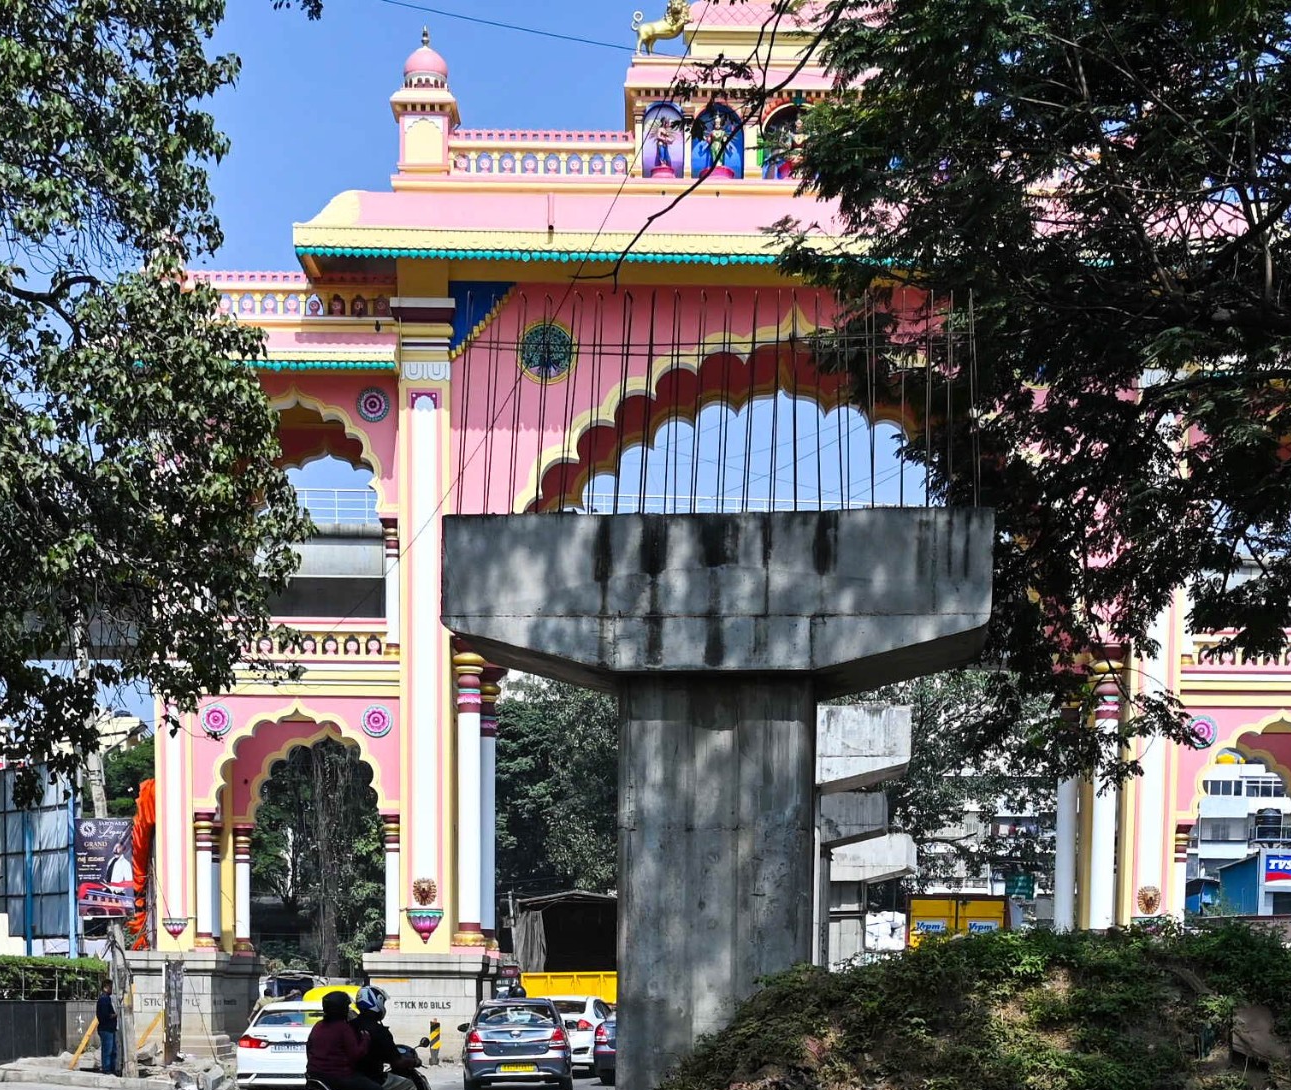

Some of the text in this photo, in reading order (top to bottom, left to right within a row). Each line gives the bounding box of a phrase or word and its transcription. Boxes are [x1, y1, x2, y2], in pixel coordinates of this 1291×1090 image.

[394, 1001, 451, 1009] STICK NO BILLS
